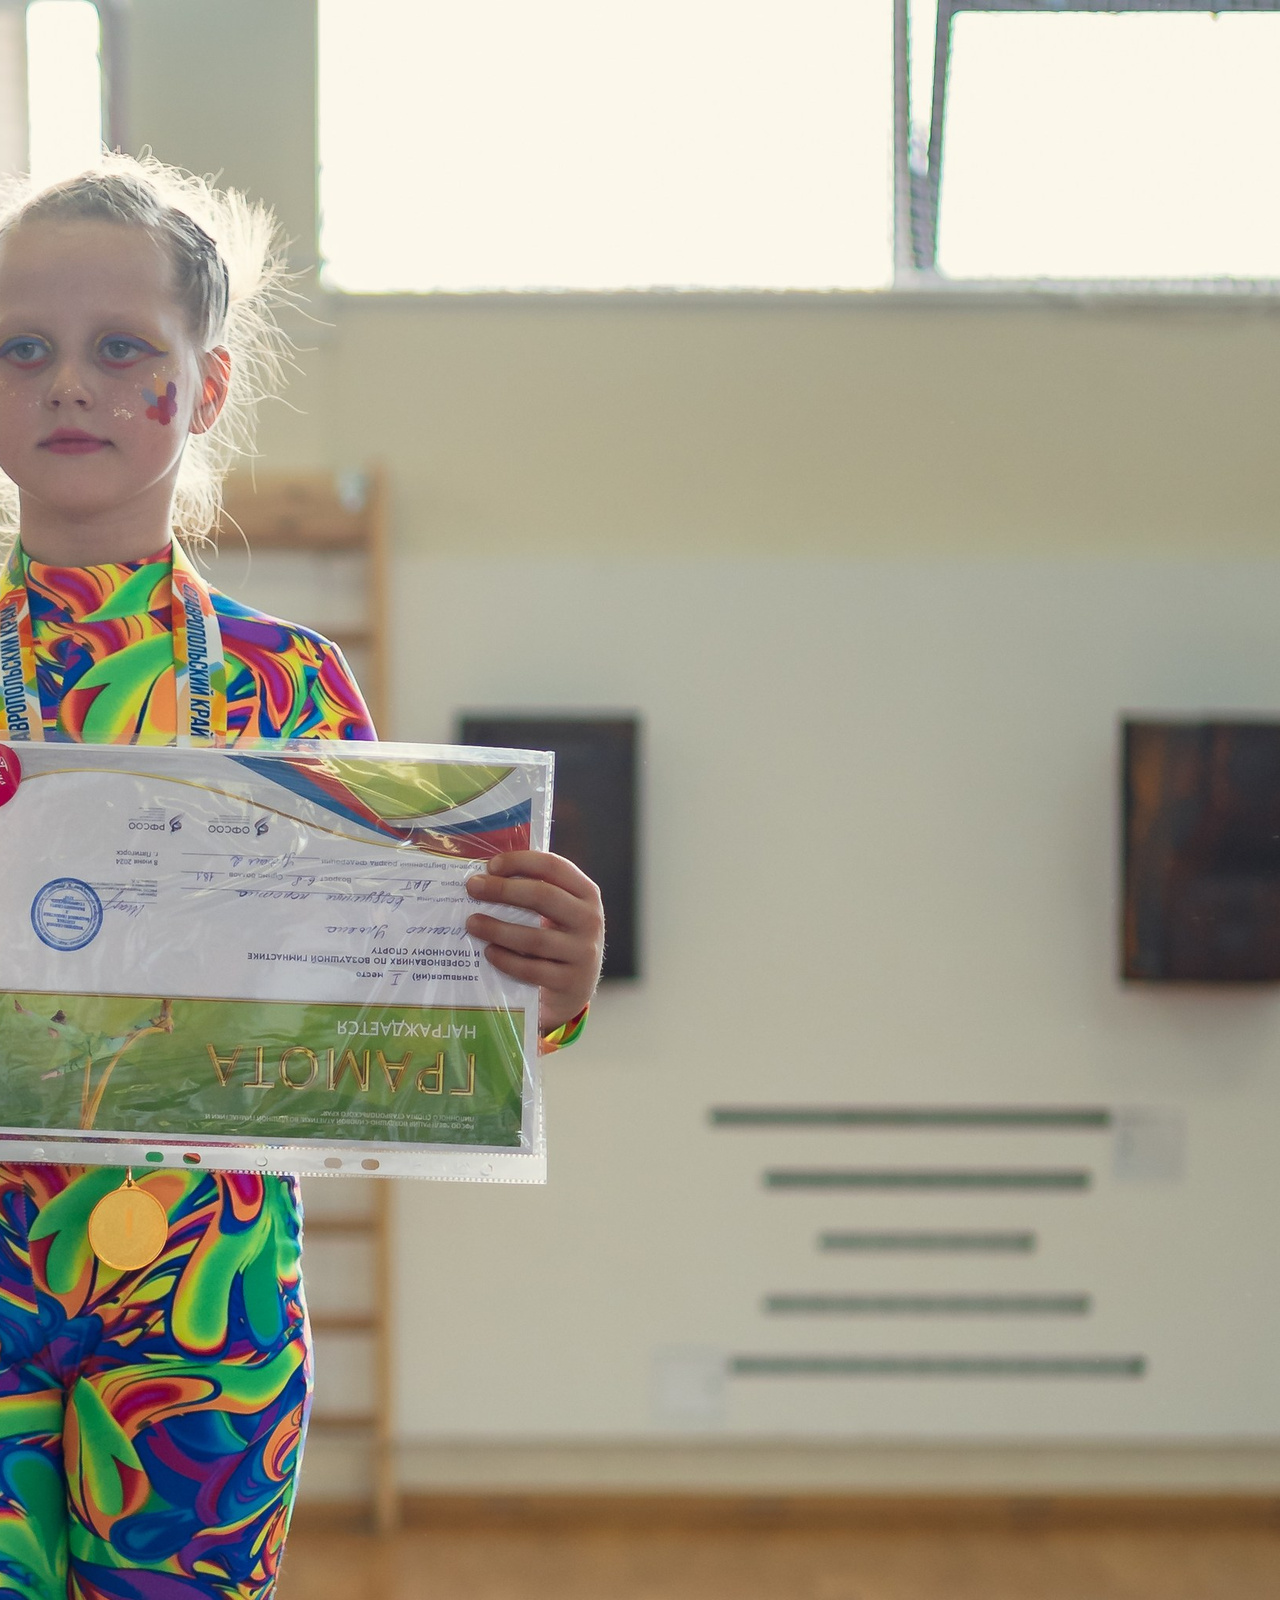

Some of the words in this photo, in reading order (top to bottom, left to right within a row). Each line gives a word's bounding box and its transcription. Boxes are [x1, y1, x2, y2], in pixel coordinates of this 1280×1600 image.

[183, 583, 214, 696] СТАВРОПОЛЬСКИЙ
[190, 698, 214, 738] КРАЙ
[128, 822, 165, 831] РФСОО
[208, 825, 250, 834] ОФСОО
[116, 850, 152, 858] Пятигорск
[320, 876, 352, 884] Возраст
[371, 947, 408, 955] СПОРТУ
[412, 948, 470, 957] ПИЛОННОМУ
[474, 950, 480, 958] И
[247, 952, 308, 962] ГИМНАСТИКЕ
[310, 954, 370, 964] ВОЗДУШНОЙ
[390, 958, 470, 968] СОРЕВНОВАНИЯХ
[474, 960, 480, 968] В
[412, 972, 478, 982] занявшая(ий)
[337, 1019, 476, 1039] НАГРАЖДАЕТСЯ
[206, 1044, 476, 1096] ГРАМОТА
